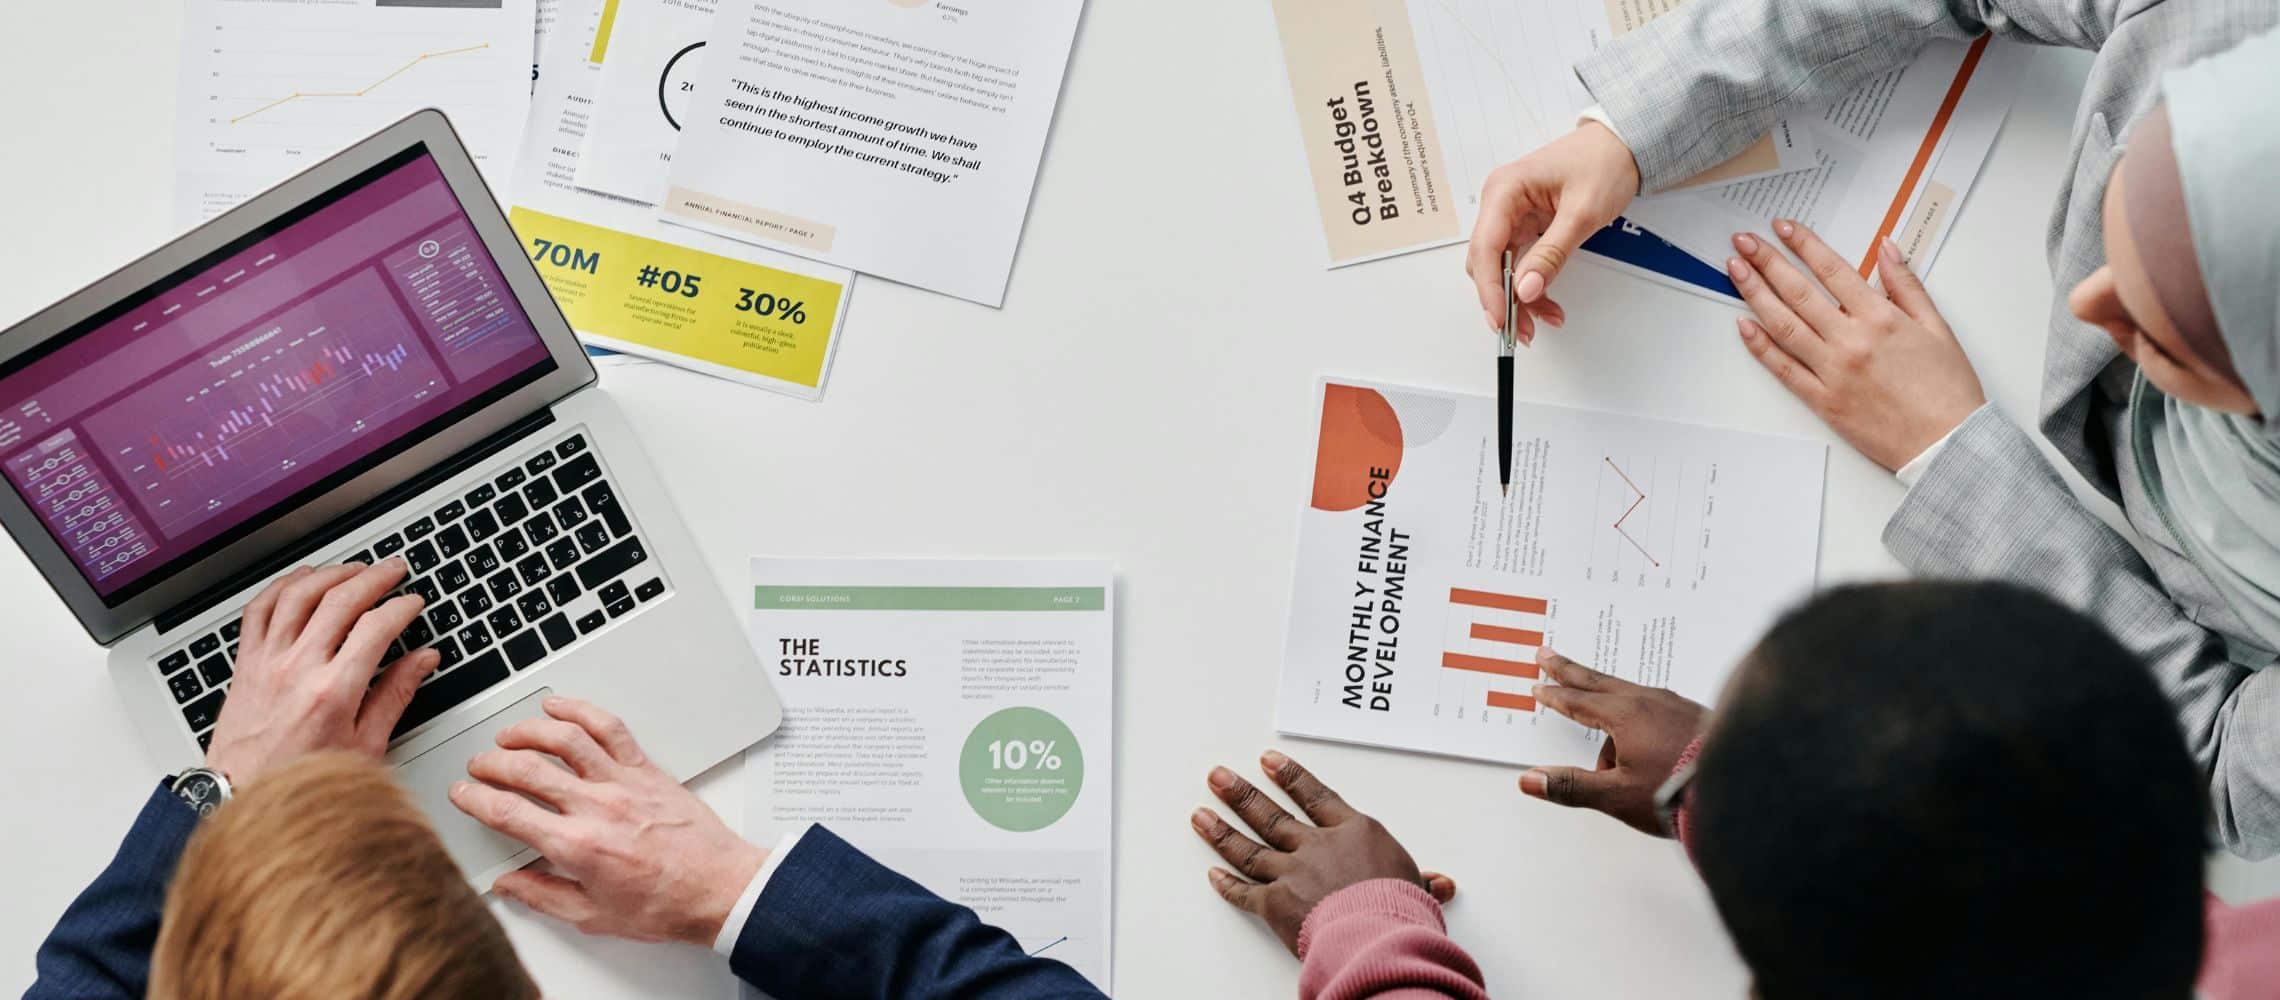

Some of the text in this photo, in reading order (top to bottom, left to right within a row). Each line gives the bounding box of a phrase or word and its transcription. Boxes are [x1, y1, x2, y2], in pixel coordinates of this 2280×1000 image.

[567, 94, 594, 104] AUDIT
[732, 78, 978, 150] "This is the highest income growth we have
[724, 98, 981, 170] seen in the shortest amount of time. We shall
[1392, 96, 1408, 140] company
[1410, 118, 1418, 130] for
[552, 146, 580, 158] DIREC
[720, 116, 958, 184] continue to employ the current strategy."
[1326, 96, 1372, 226] Q4 Budget
[1353, 80, 1400, 220] Breakdown
[1402, 140, 1410, 157] the
[1404, 154, 1414, 166] of
[1408, 166, 1424, 206] summary
[1426, 194, 1438, 212] and
[684, 201, 713, 213] ANNUAL
[715, 209, 753, 223] FINANCIAL
[755, 219, 783, 231] REPORT
[789, 228, 808, 237] PAGE
[534, 238, 600, 274] 70M
[637, 265, 701, 298] #05
[735, 287, 806, 324] 30%
[1342, 464, 1391, 708] MONTHLY FINANCE
[1370, 528, 1410, 712] DEVELOPMENT
[779, 638, 820, 655] THE
[779, 659, 907, 677] STATISTICS
[988, 740, 1061, 770] 10%
